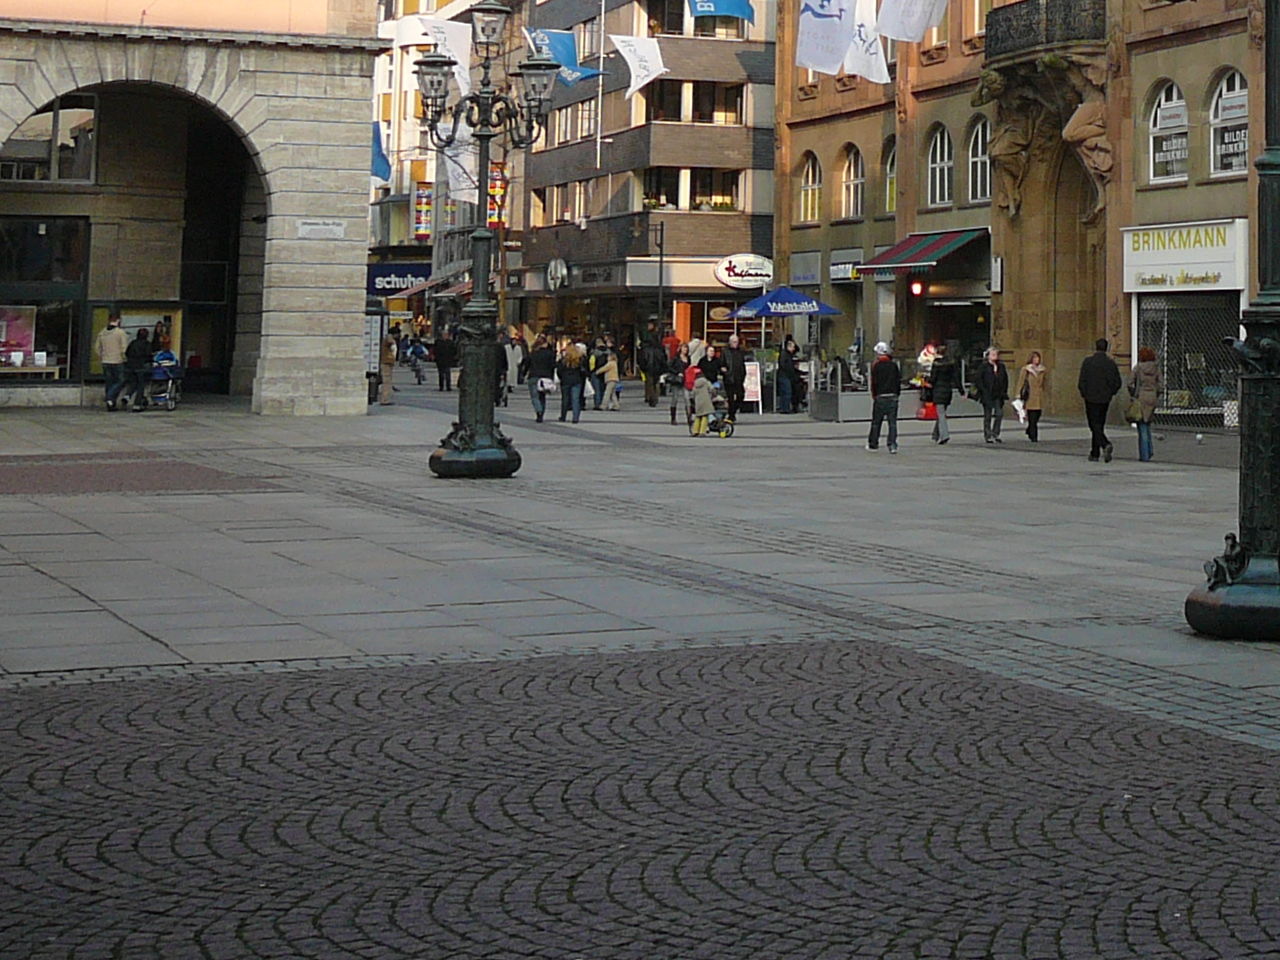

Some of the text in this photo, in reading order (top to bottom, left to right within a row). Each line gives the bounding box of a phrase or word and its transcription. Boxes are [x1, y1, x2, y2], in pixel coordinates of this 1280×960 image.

[1224, 129, 1248, 143] BILDE
[1132, 227, 1227, 252] BRINKMANN
[767, 300, 819, 313] Weltbild
